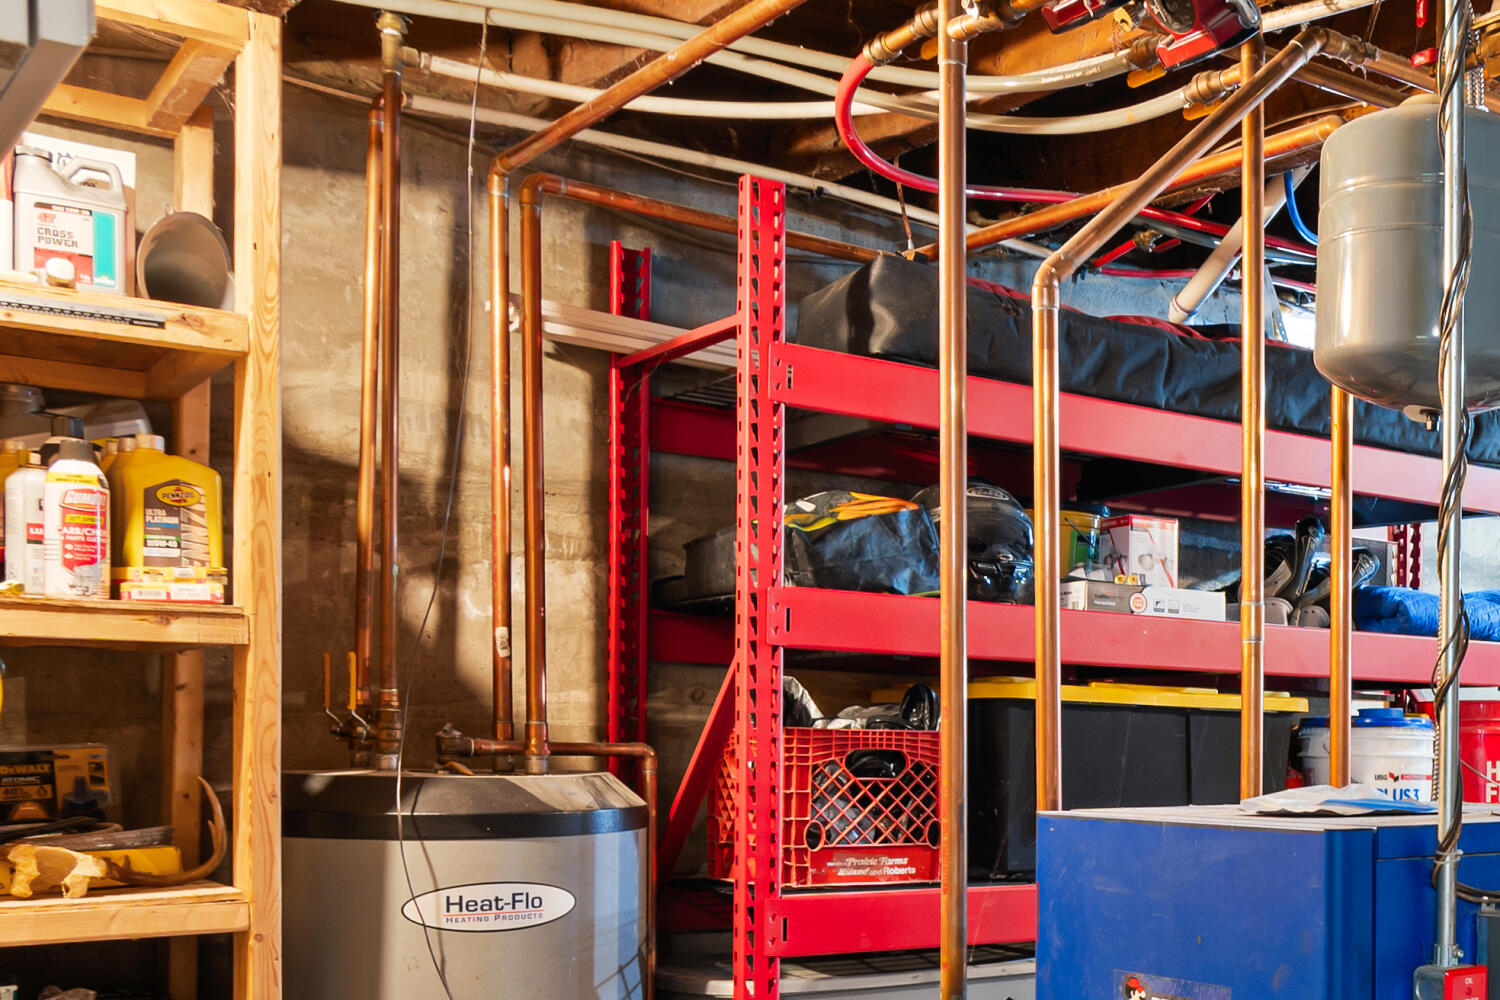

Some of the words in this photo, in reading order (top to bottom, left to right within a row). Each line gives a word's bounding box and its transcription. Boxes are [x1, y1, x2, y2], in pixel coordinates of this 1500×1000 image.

[37, 226, 75, 240] CROSS
[37, 235, 79, 249] POWER
[879, 856, 908, 865] Farms
[883, 866, 916, 875] Roberts
[445, 892, 543, 913] Heat-Flo
[494, 913, 543, 922] PRODUCTS
